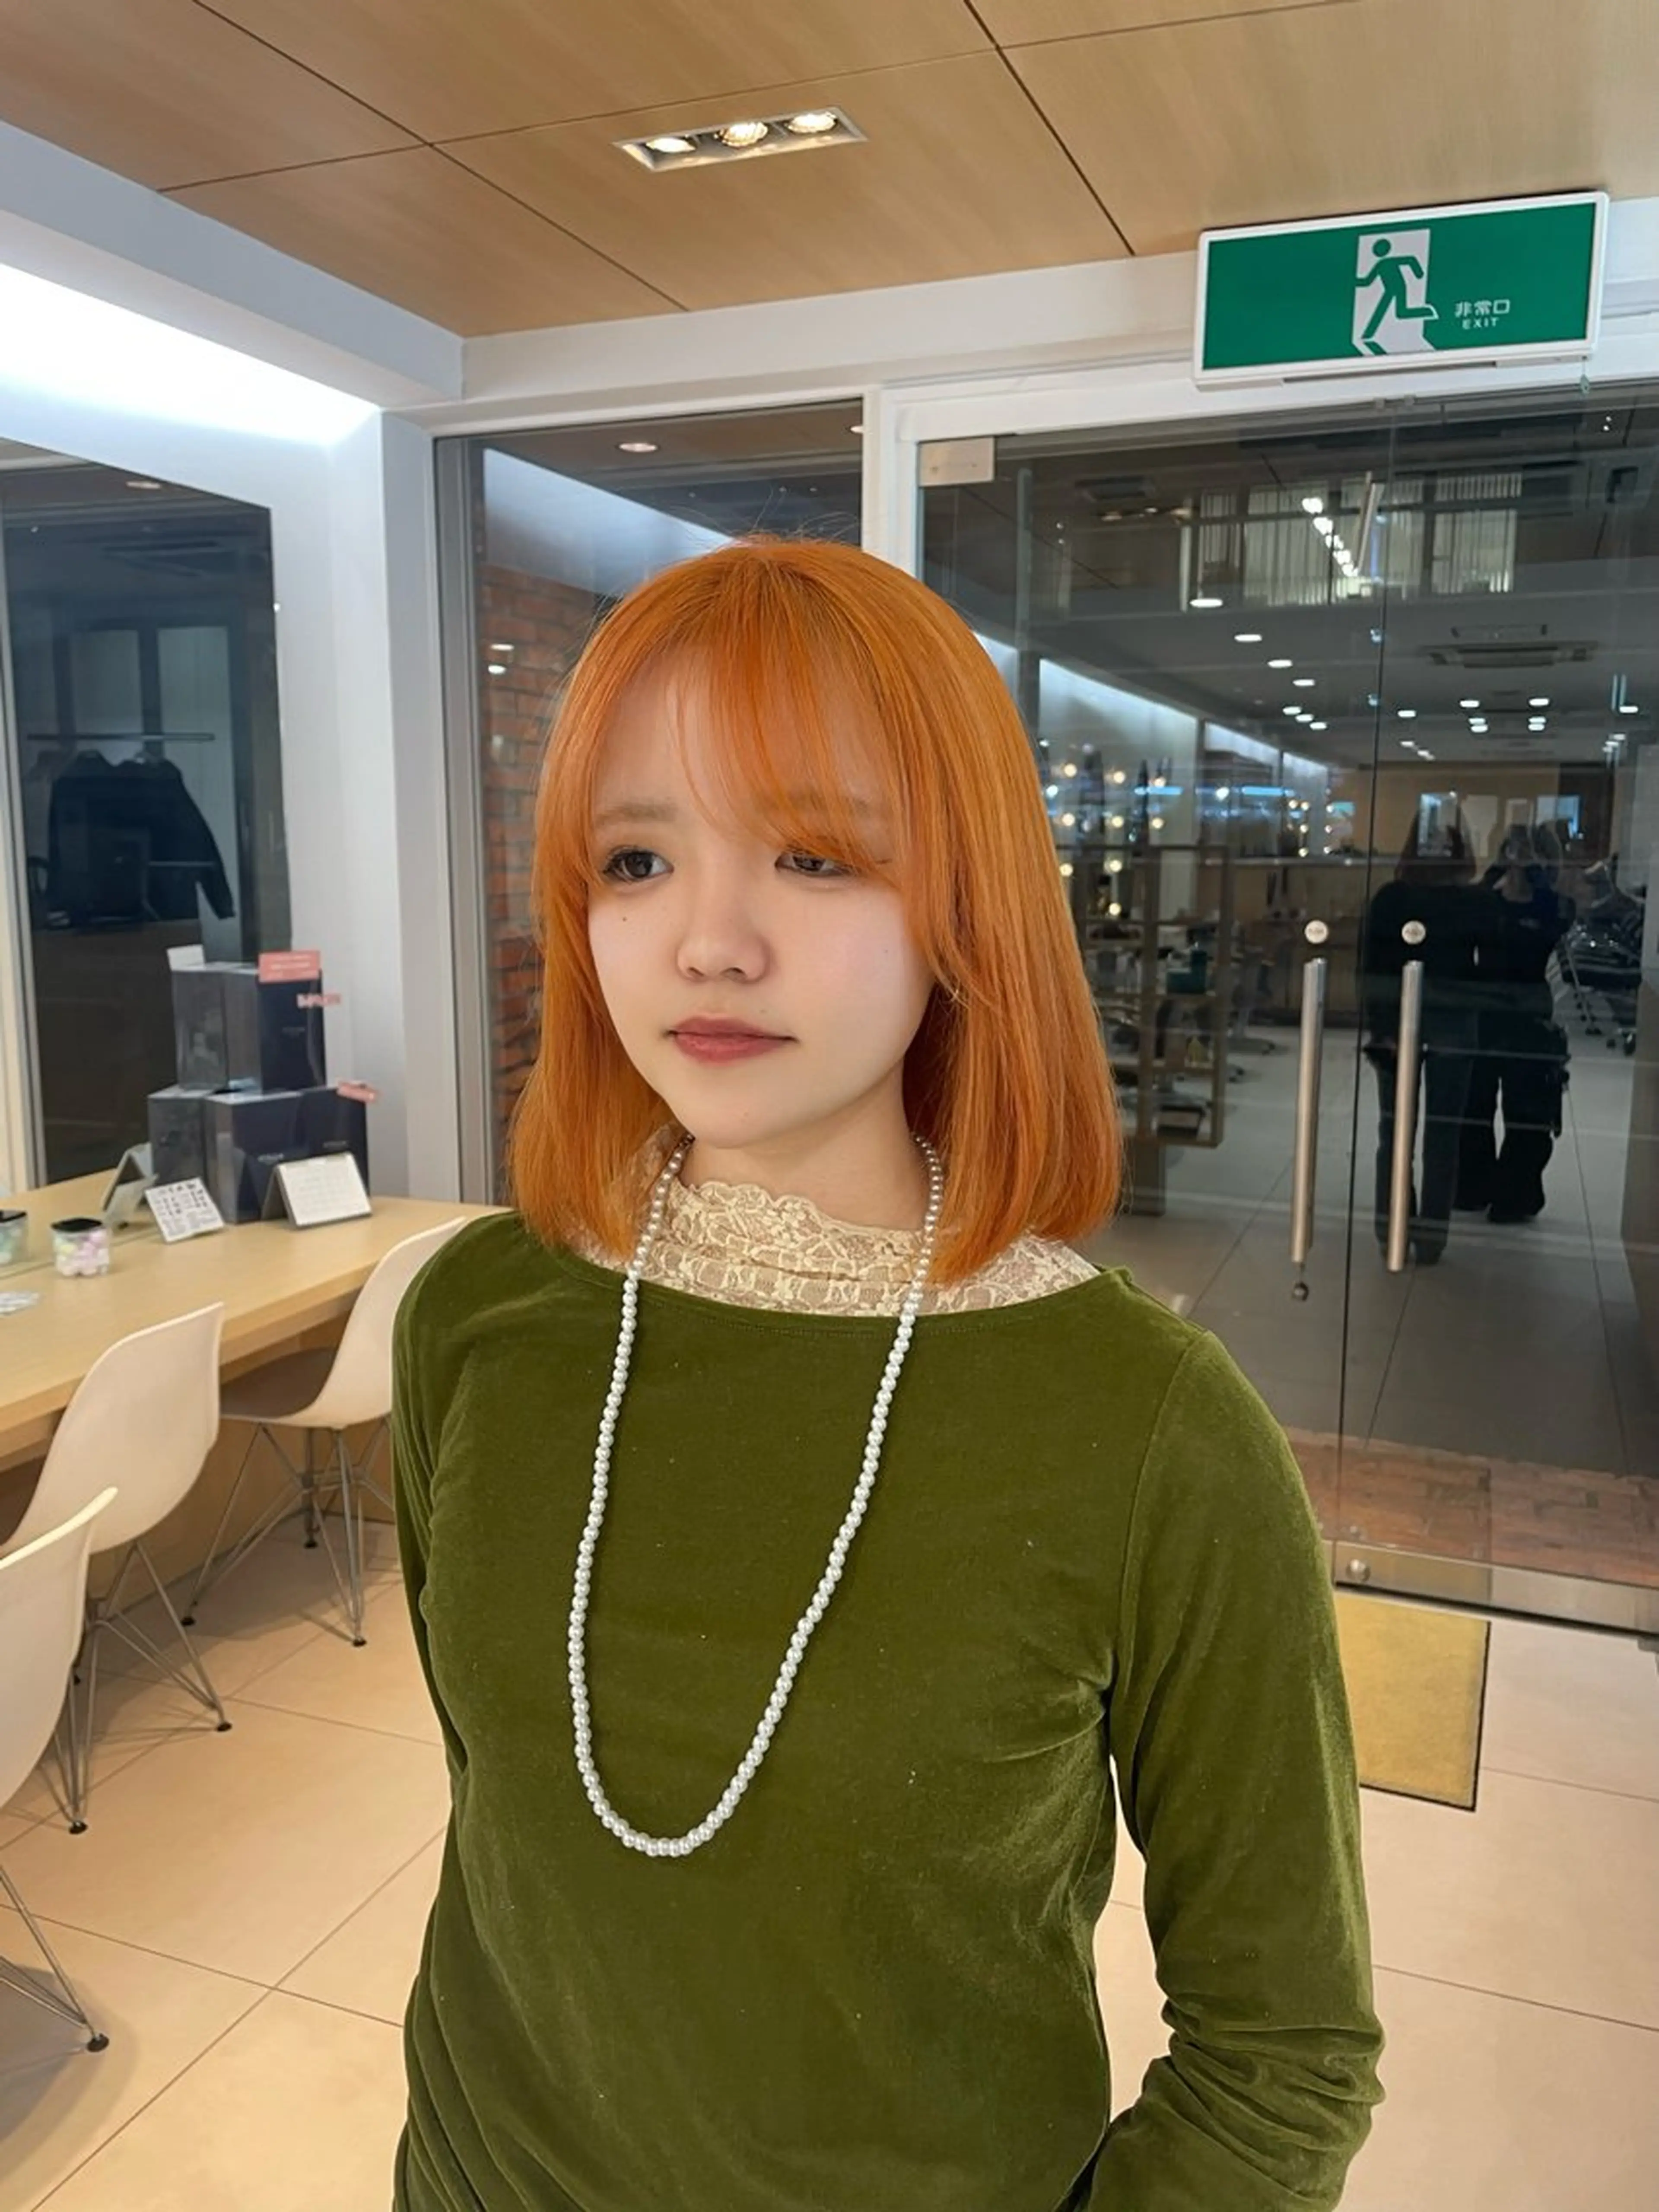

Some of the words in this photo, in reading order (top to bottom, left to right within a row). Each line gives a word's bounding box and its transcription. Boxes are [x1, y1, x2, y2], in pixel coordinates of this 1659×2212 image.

[1455, 299, 1510, 317] 非常口
[1462, 317, 1500, 330] EXIT
